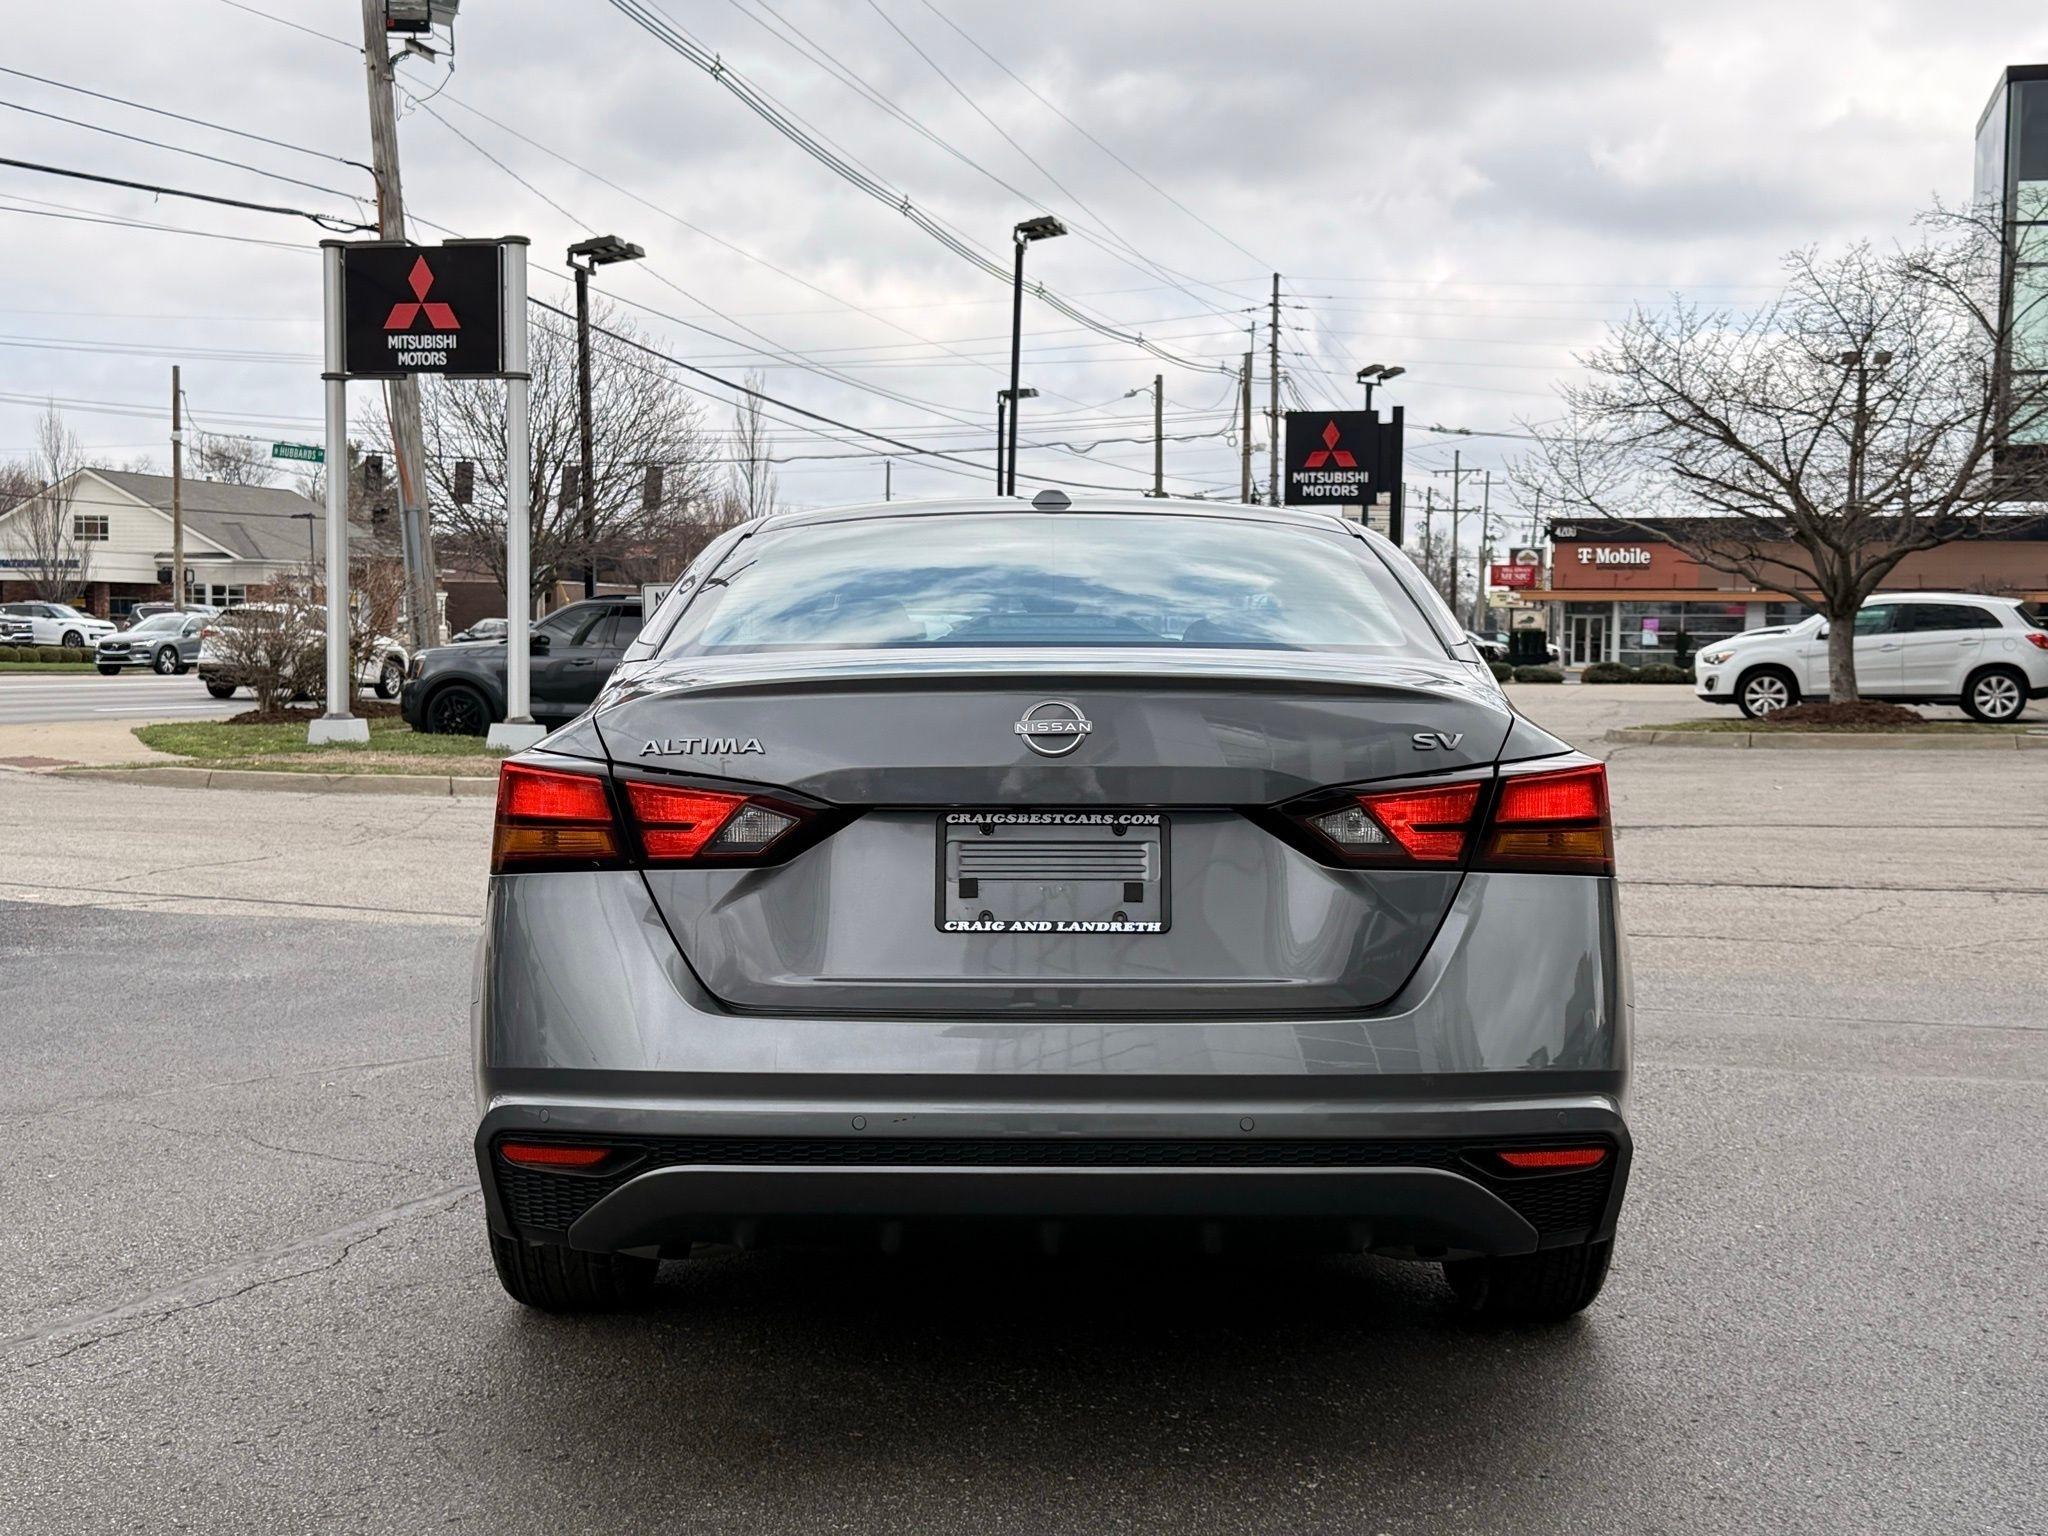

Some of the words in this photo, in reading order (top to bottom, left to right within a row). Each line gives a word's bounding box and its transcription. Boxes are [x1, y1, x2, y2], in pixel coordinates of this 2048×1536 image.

[388, 334, 457, 350] MITSUBISHI
[398, 351, 447, 366] MOTORS
[280, 446, 316, 460] HUBBARDS
[1292, 471, 1369, 484] MITSUBISHI
[1302, 484, 1359, 497] MOTORS
[1016, 722, 1091, 732] NISSAN
[639, 738, 766, 757] ALTIMA
[1412, 732, 1464, 751] SV
[945, 813, 1160, 825] CRAIGSBESTCARS.COM
[944, 920, 1006, 932] CRAIG
[1009, 921, 1053, 932] AND
[1056, 921, 1162, 933] LANDRETH
